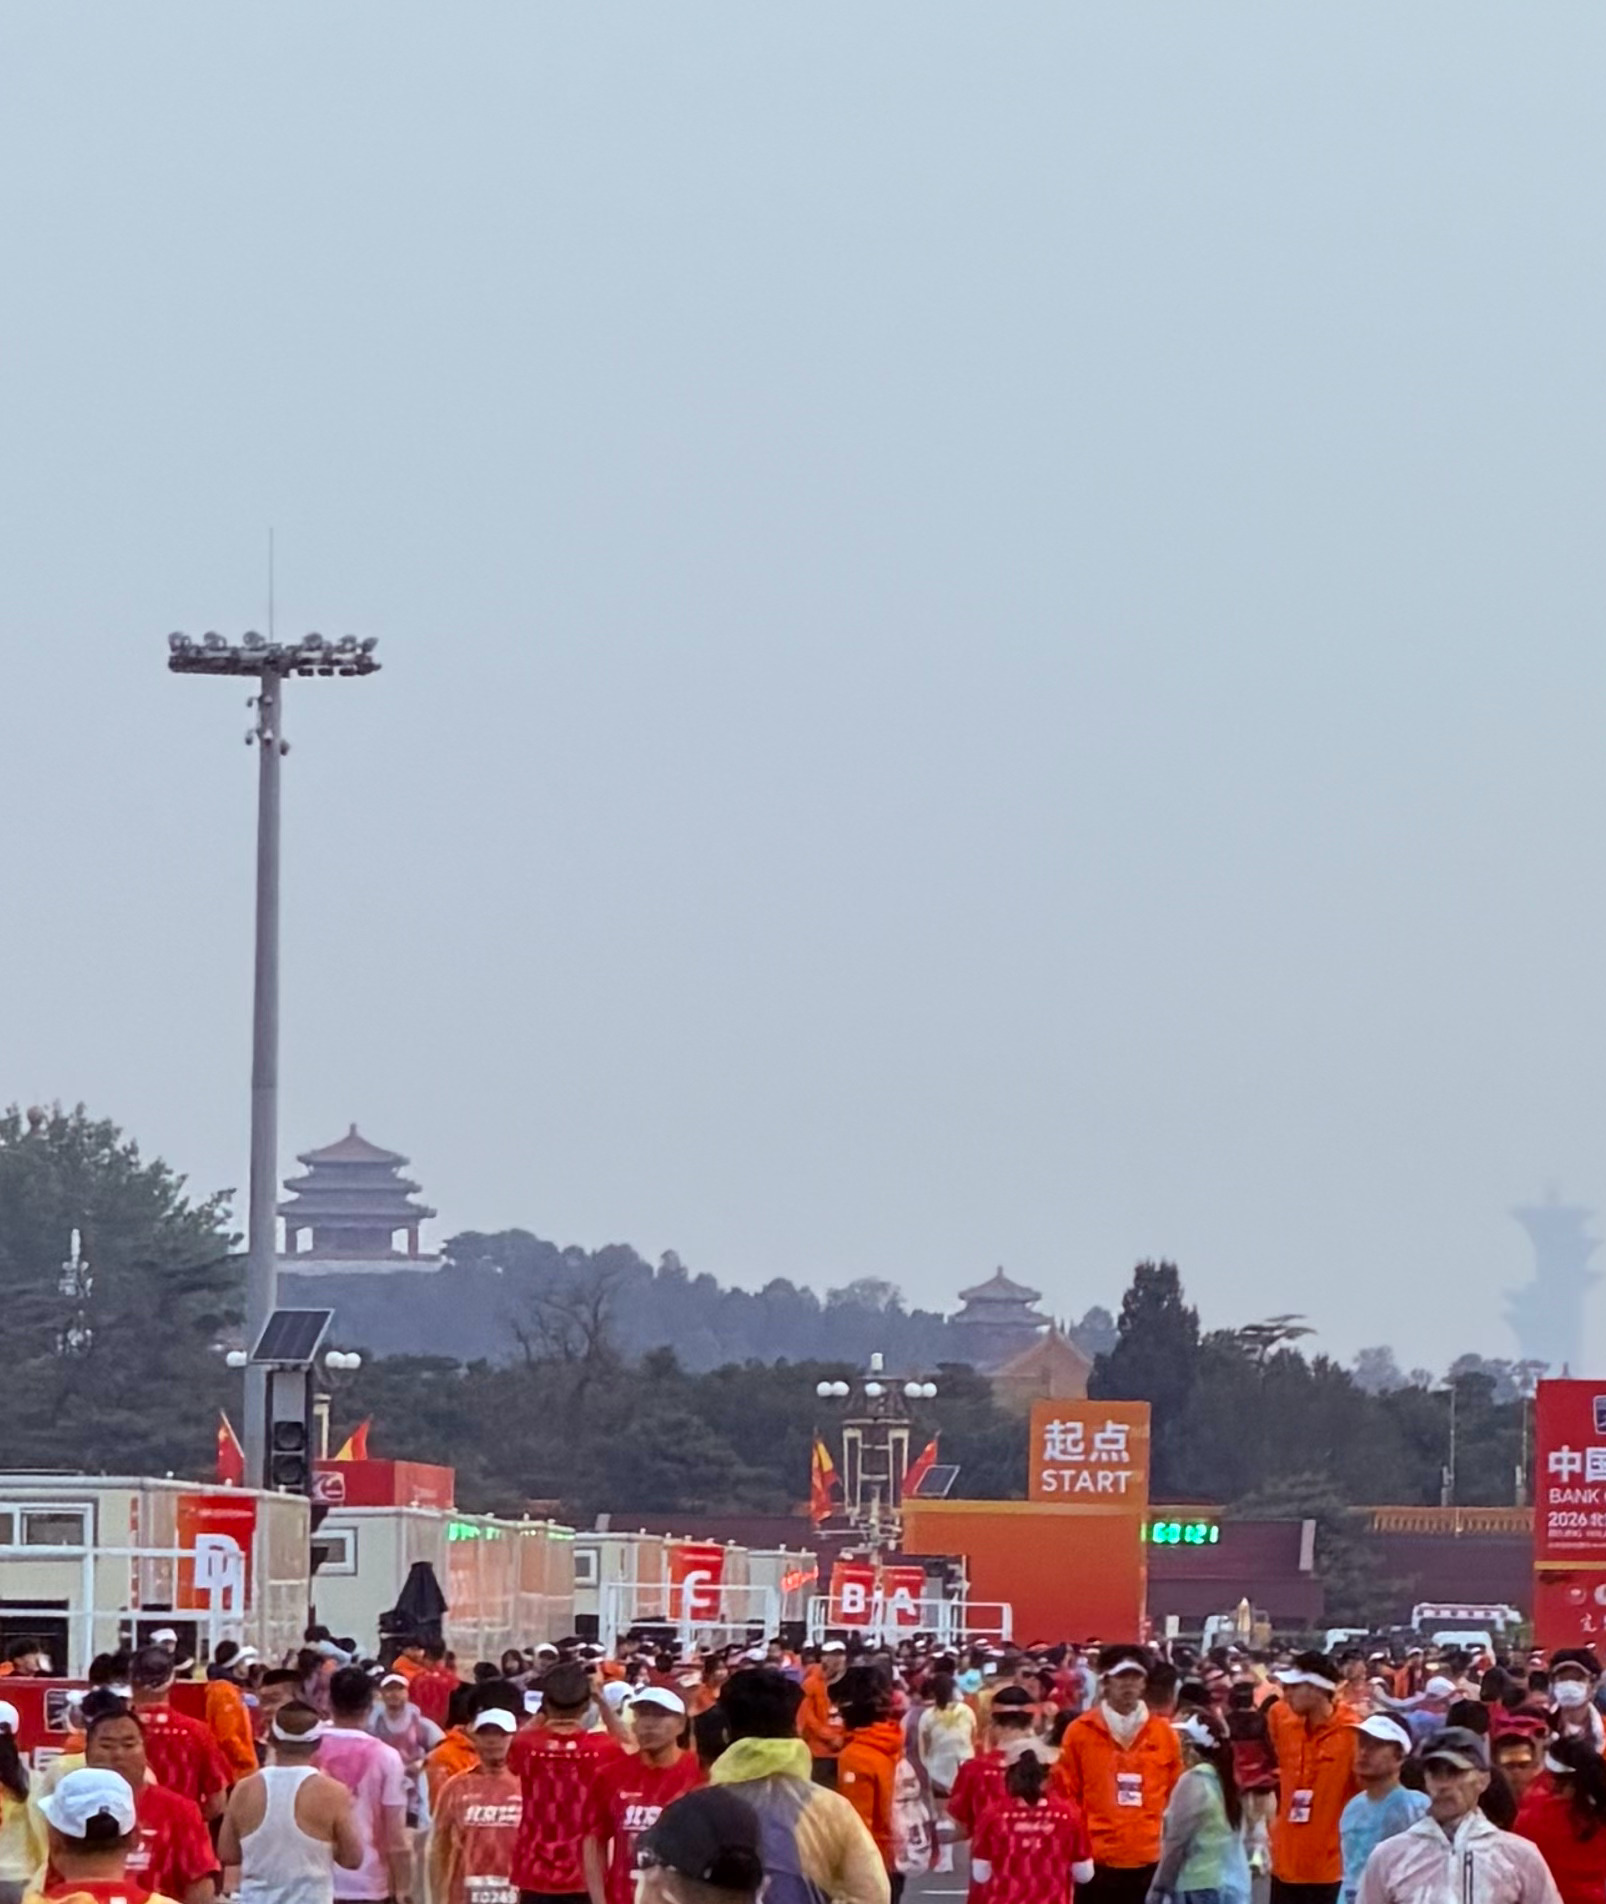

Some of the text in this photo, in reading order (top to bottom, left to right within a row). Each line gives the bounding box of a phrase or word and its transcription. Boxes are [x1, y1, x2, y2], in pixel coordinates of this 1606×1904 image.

[1043, 1419, 1130, 1462] 起点
[1042, 1469, 1132, 1493] START
[1549, 1489, 1599, 1505] BANK
[1548, 1511, 1588, 1527] 2026
[682, 1570, 712, 1608] C
[842, 1583, 865, 1613] B
[889, 1587, 917, 1616] A
